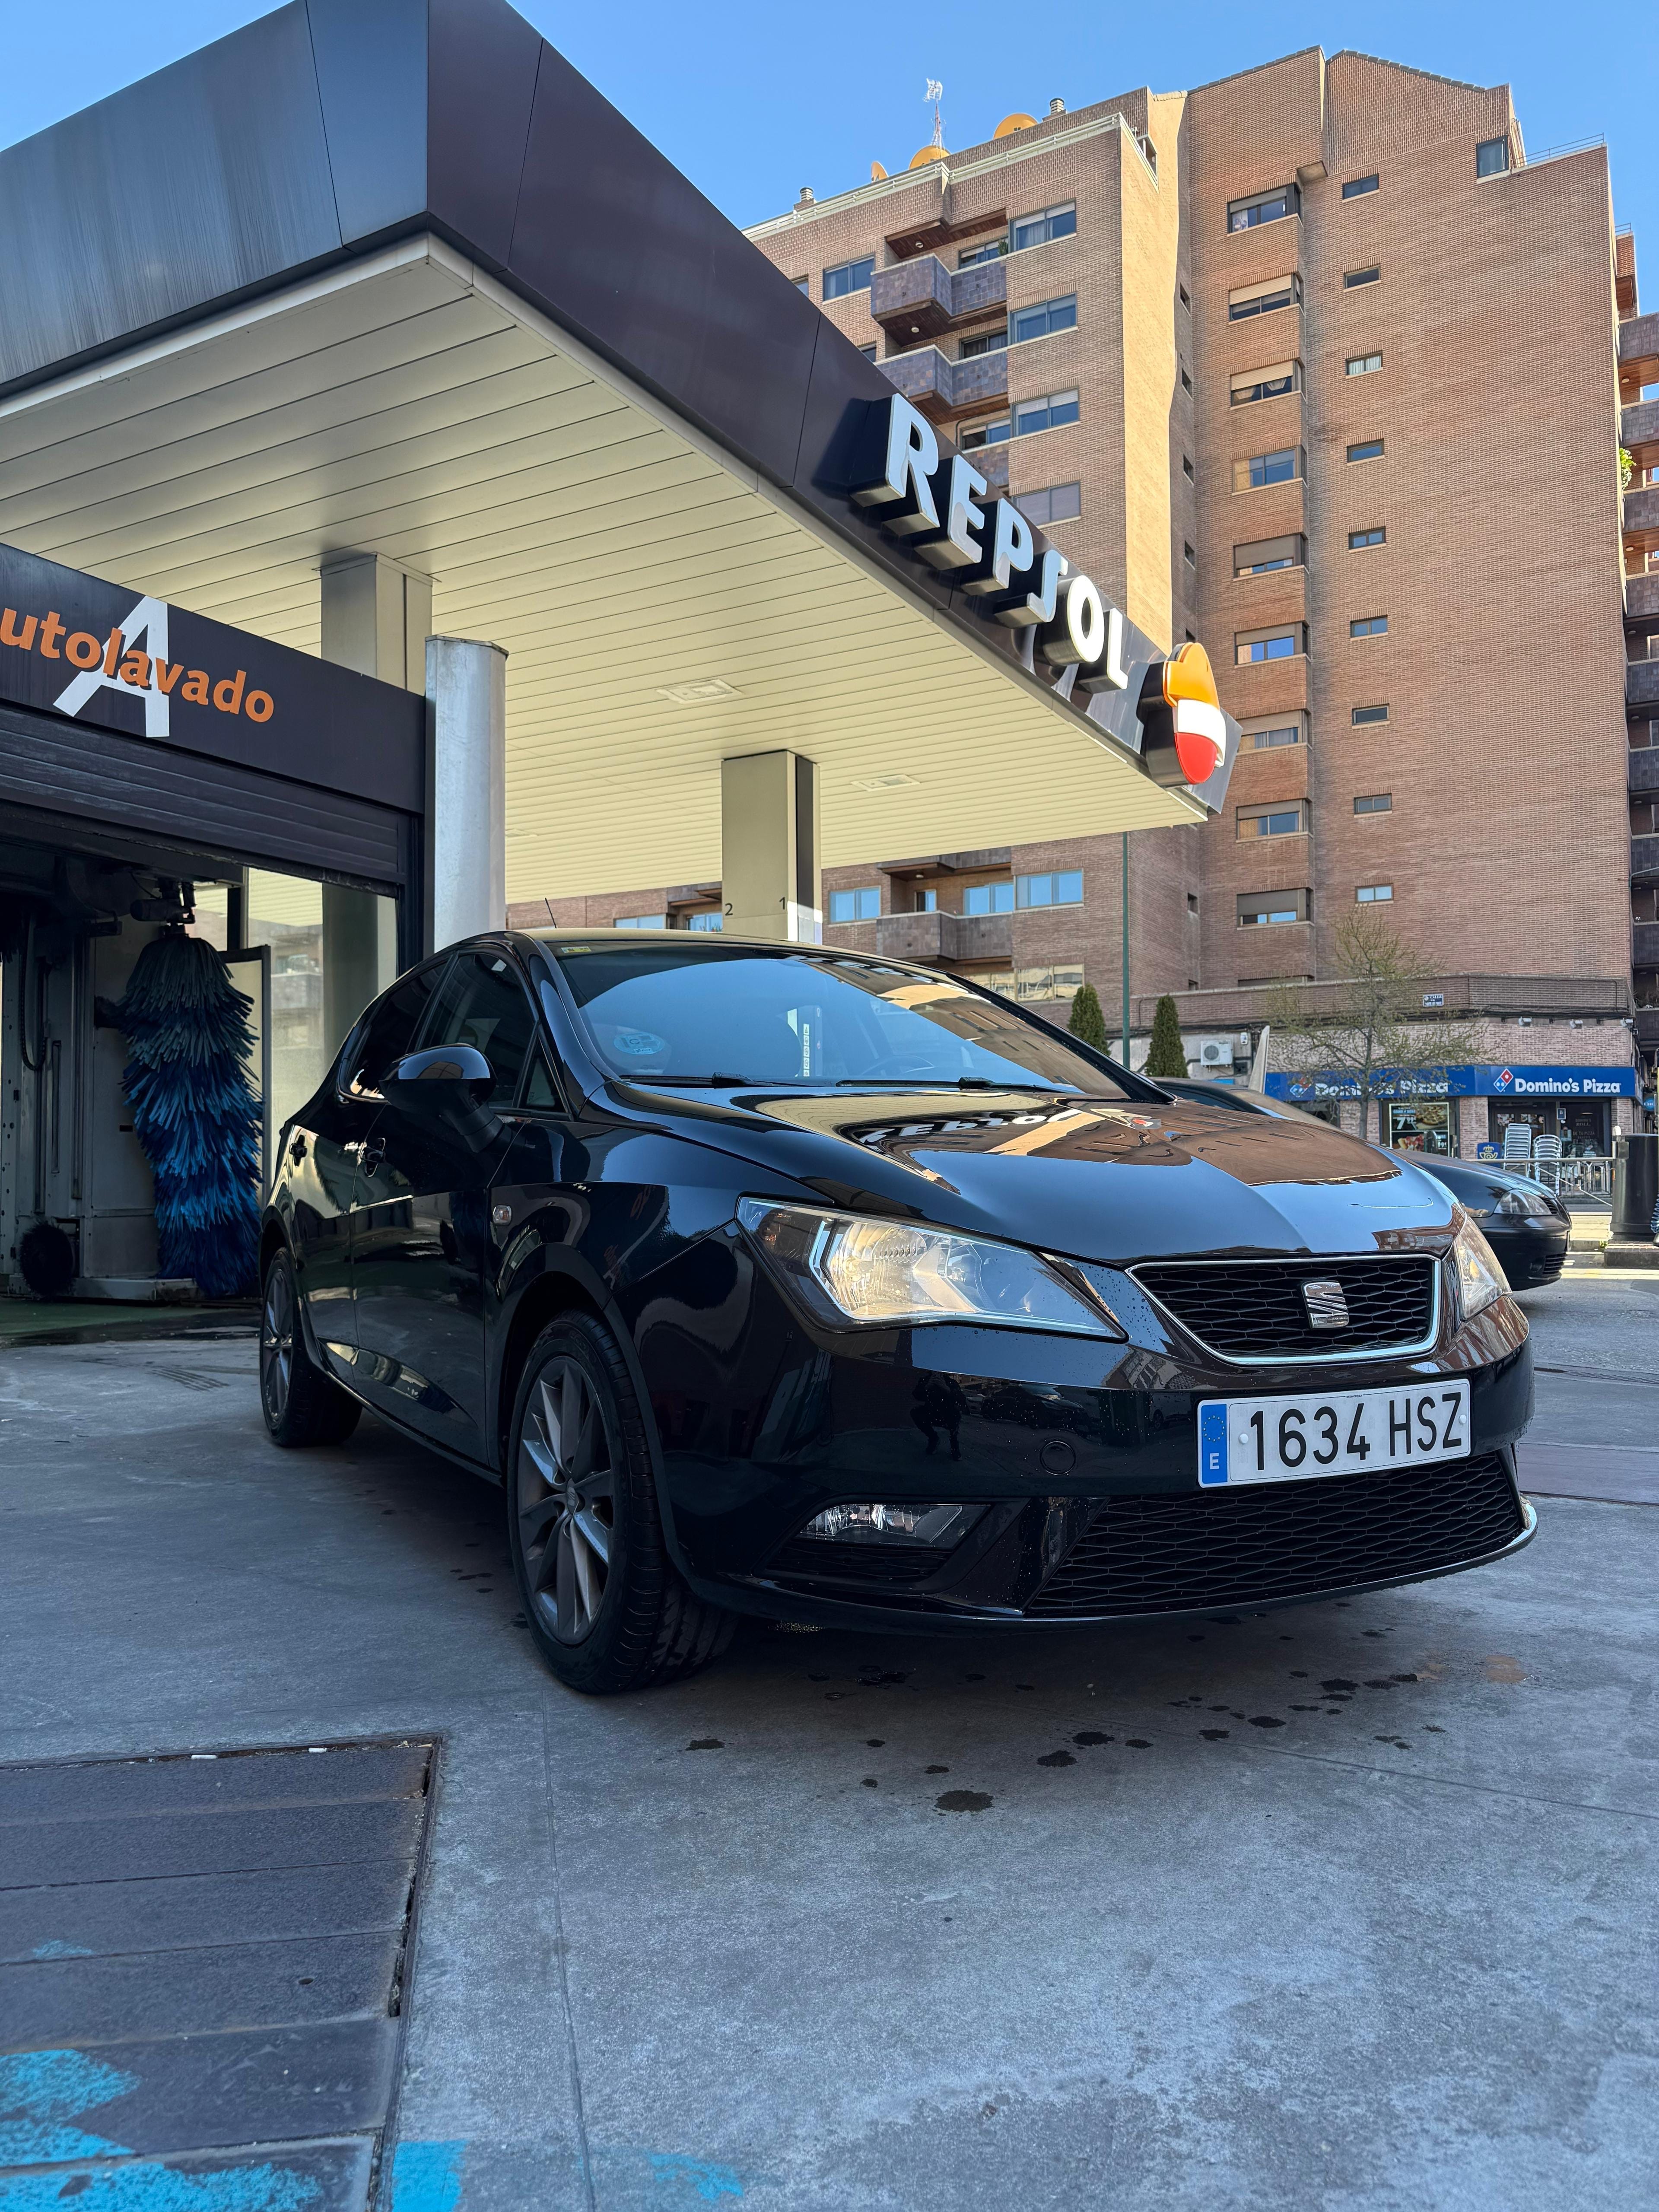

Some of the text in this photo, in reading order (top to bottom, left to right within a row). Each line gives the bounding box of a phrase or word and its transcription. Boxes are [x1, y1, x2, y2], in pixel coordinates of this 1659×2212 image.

[886, 393, 1128, 690] REPSOL
[0, 607, 274, 723] utolavado
[725, 903, 734, 916] 2
[779, 897, 786, 910] 1
[1400, 1079, 1448, 1093] Pizza
[1515, 1077, 1620, 1093] Domino's Pizza
[1250, 1392, 1462, 1471] 1634 HSZ
[1210, 1452, 1220, 1470] E
